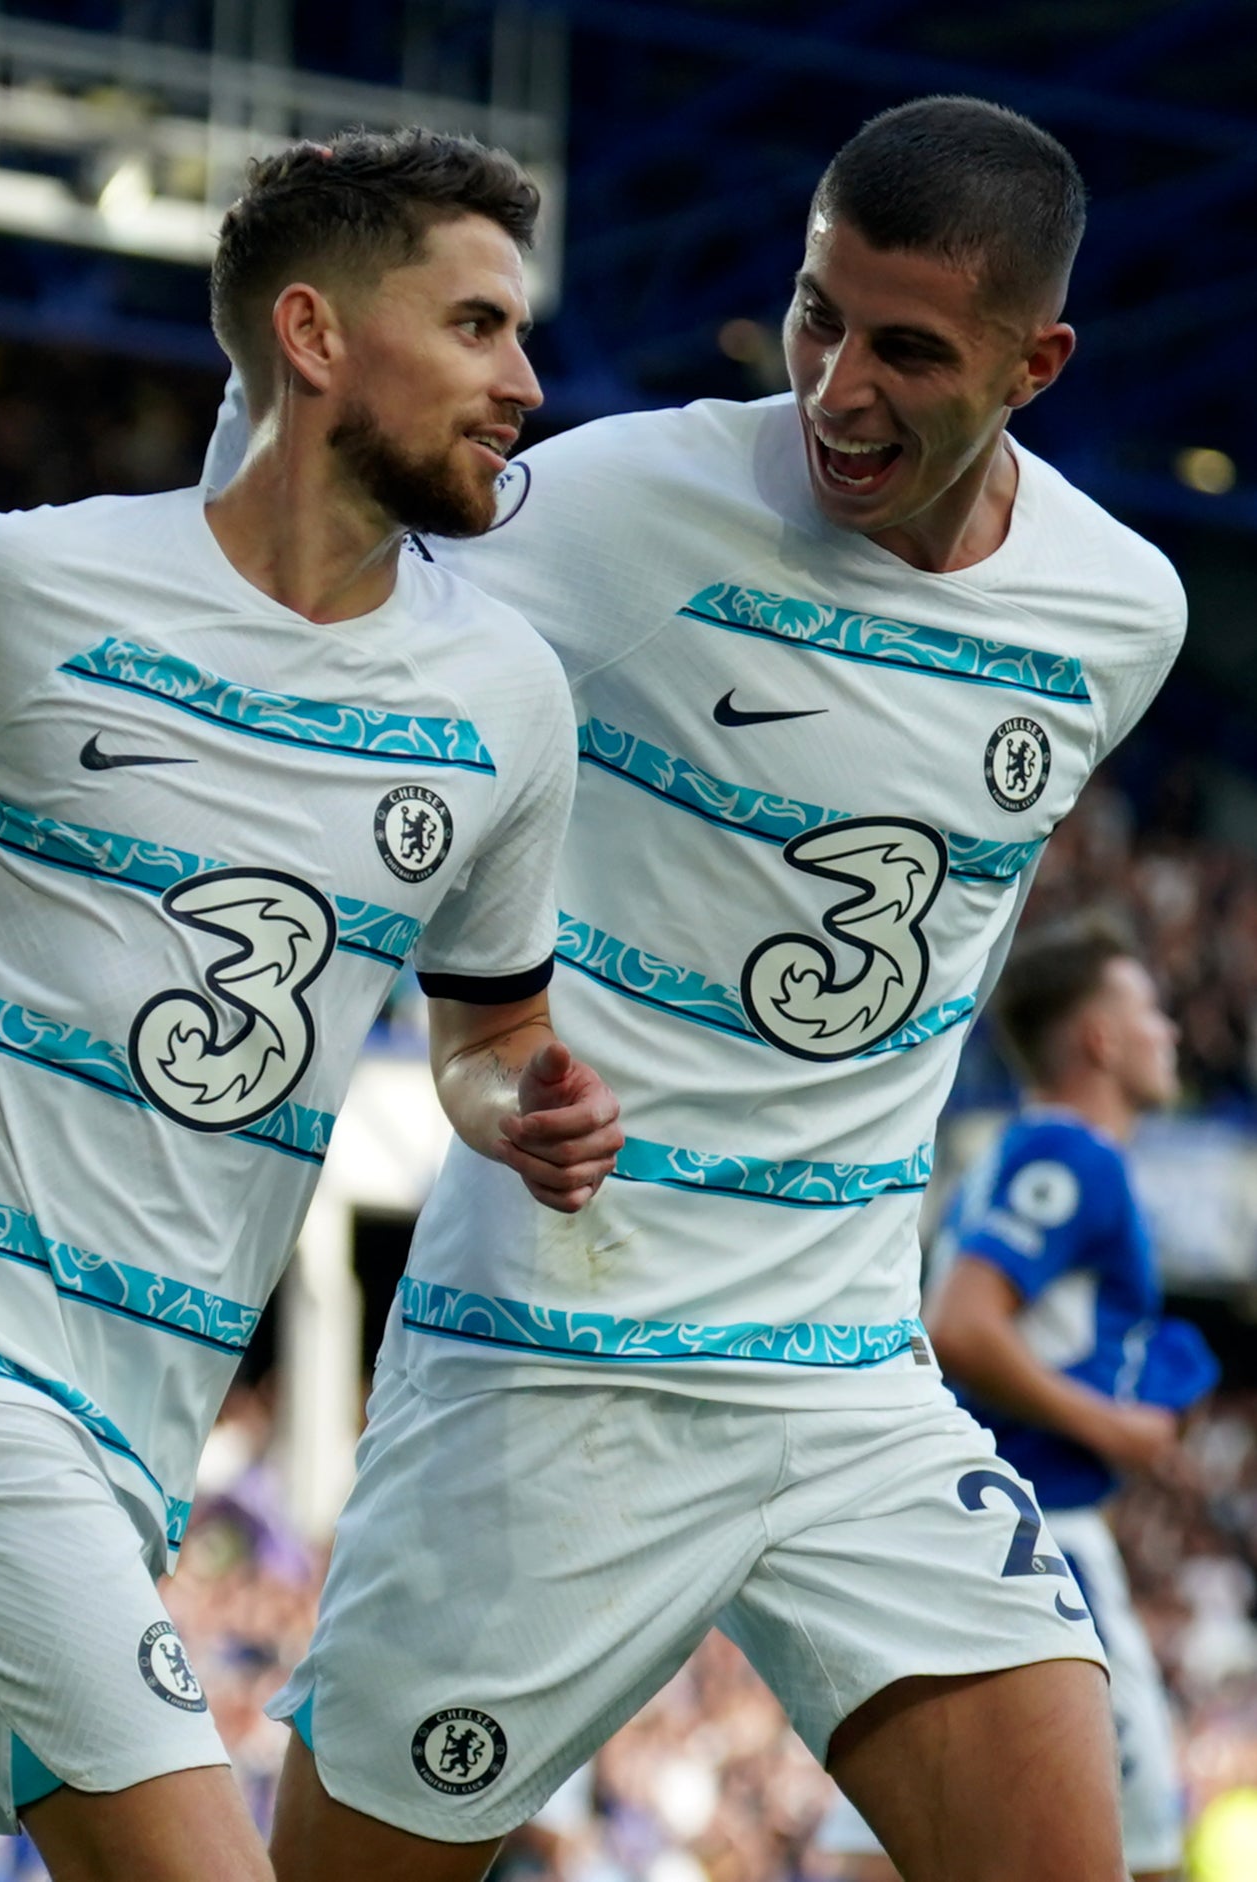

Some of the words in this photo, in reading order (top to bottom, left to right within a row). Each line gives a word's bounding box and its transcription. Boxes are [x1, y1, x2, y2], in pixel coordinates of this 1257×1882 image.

[997, 719, 1044, 742] CHELSEA
[389, 787, 448, 816] CHELSEA
[740, 816, 948, 1063] 3
[128, 867, 337, 1133] 3
[957, 1470, 1069, 1578] 2
[436, 1709, 498, 1735] CHELSEA
